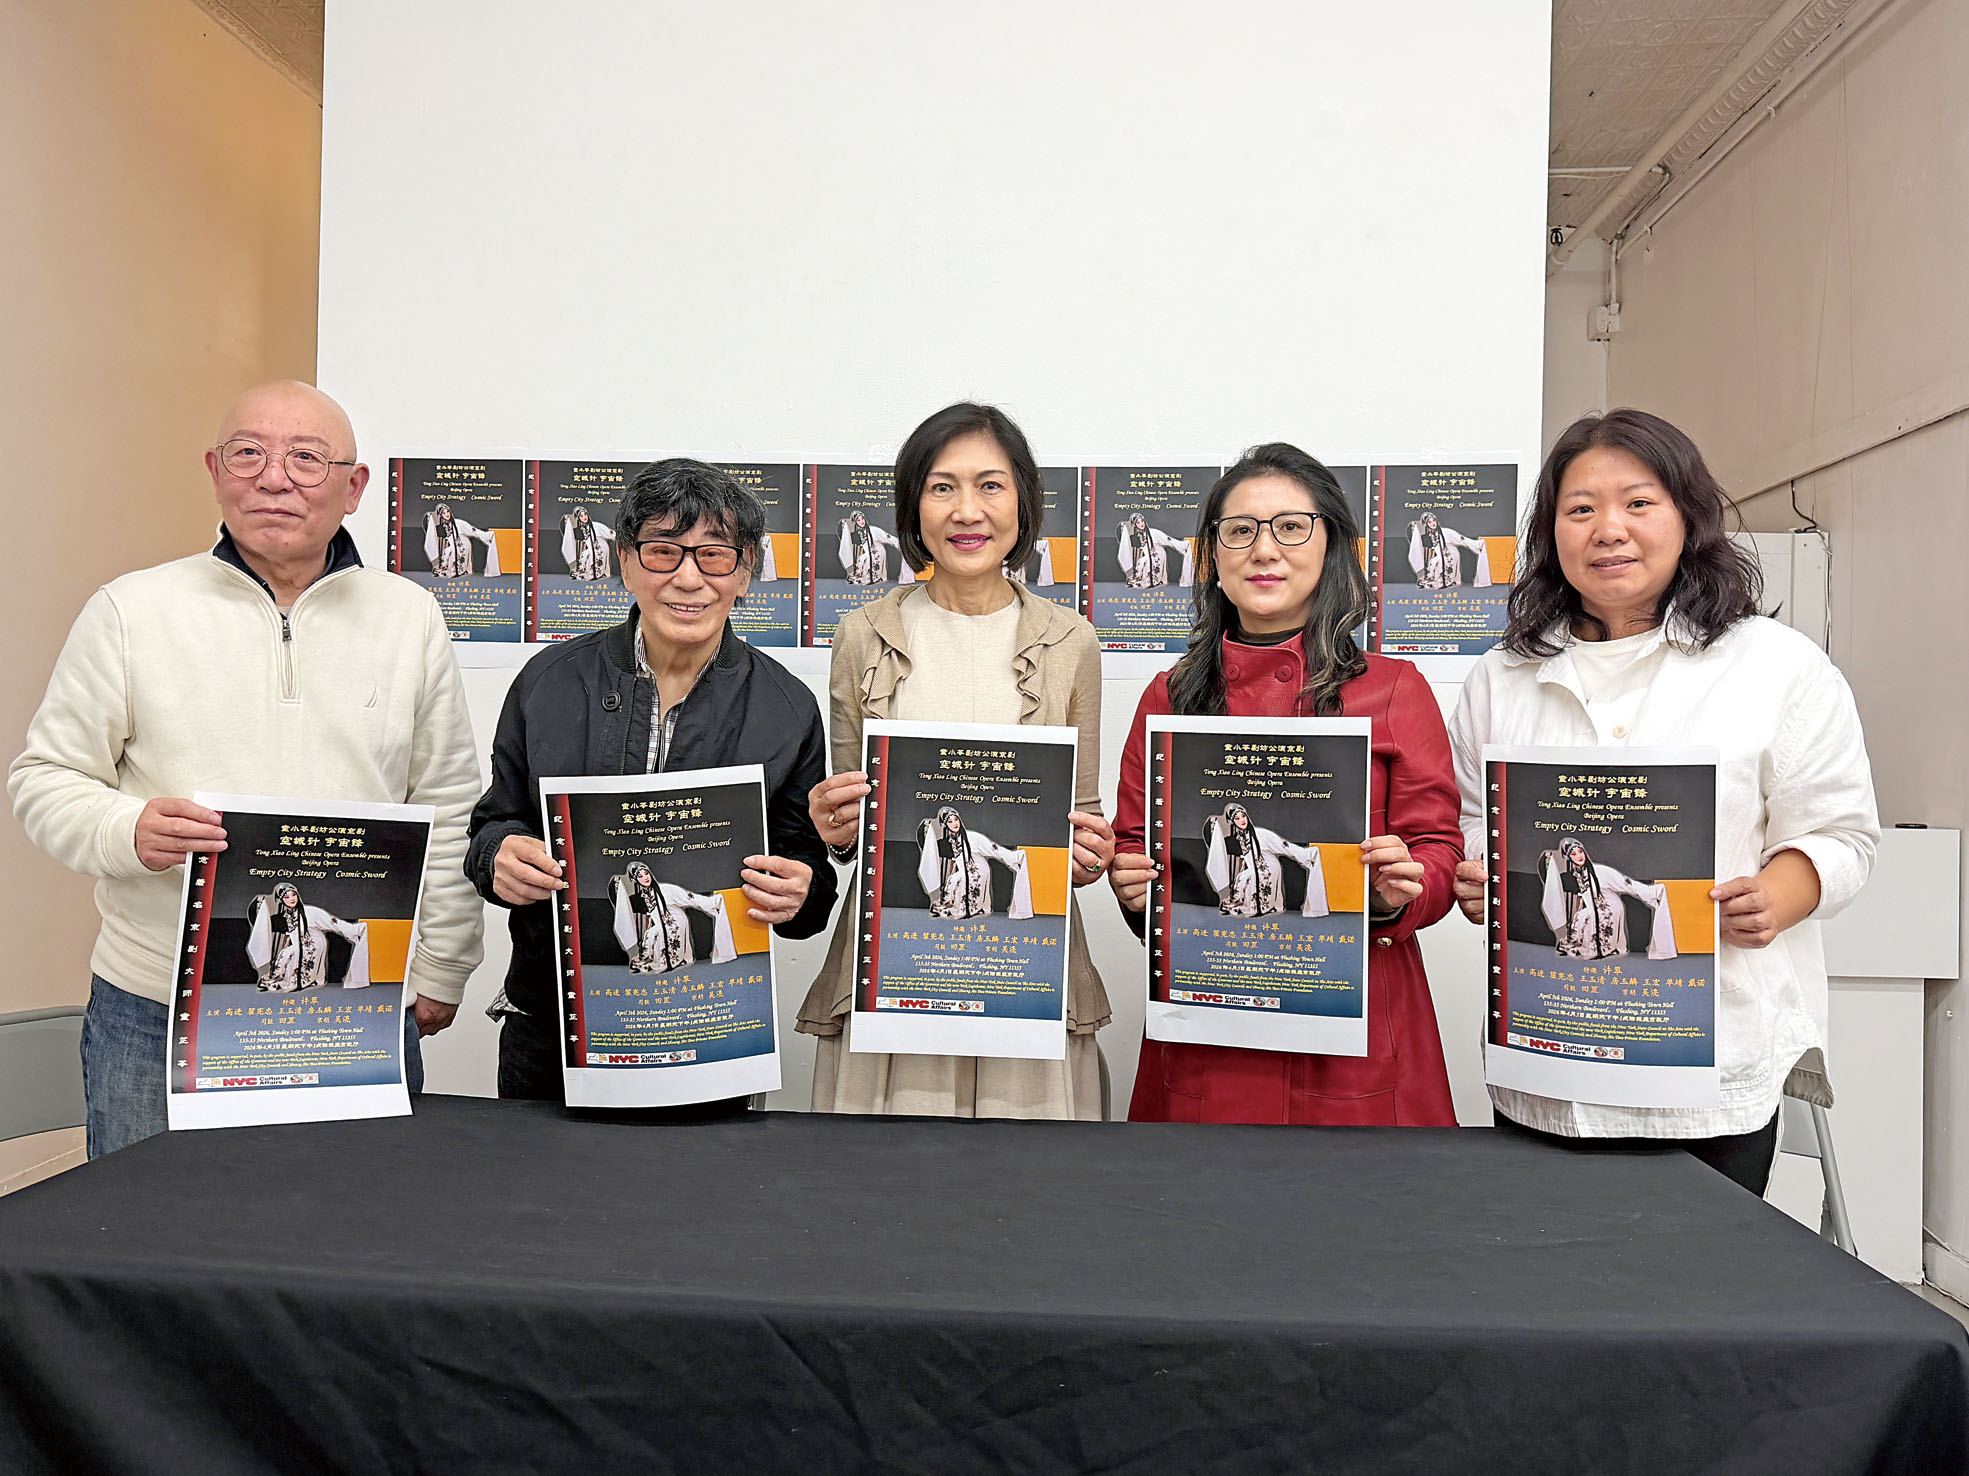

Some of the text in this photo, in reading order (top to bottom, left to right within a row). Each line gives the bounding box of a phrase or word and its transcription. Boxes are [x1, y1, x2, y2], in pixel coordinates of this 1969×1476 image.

[915, 792, 1040, 804] Empty City Strategy Cosmic Sword
[1200, 788, 1332, 799] Empty City Strategy Cosmic Sword
[1567, 802, 1580, 810] Ling
[1606, 803, 1623, 811] Opera
[684, 822, 708, 830] Ensemble
[1534, 821, 1679, 834] Empty City Strategy Cosmic Sword
[602, 838, 732, 857] Empty City Strategy Cosmic Sword
[302, 859, 321, 867] Beijing
[249, 868, 387, 879] Empty City Strategy Cosmic Sword
[1193, 993, 1223, 1003] NYC
[900, 1000, 929, 1008] NYC
[1530, 1039, 1561, 1052] NYC
[1563, 1044, 1591, 1052] Cultural
[223, 1078, 257, 1086] NYC
